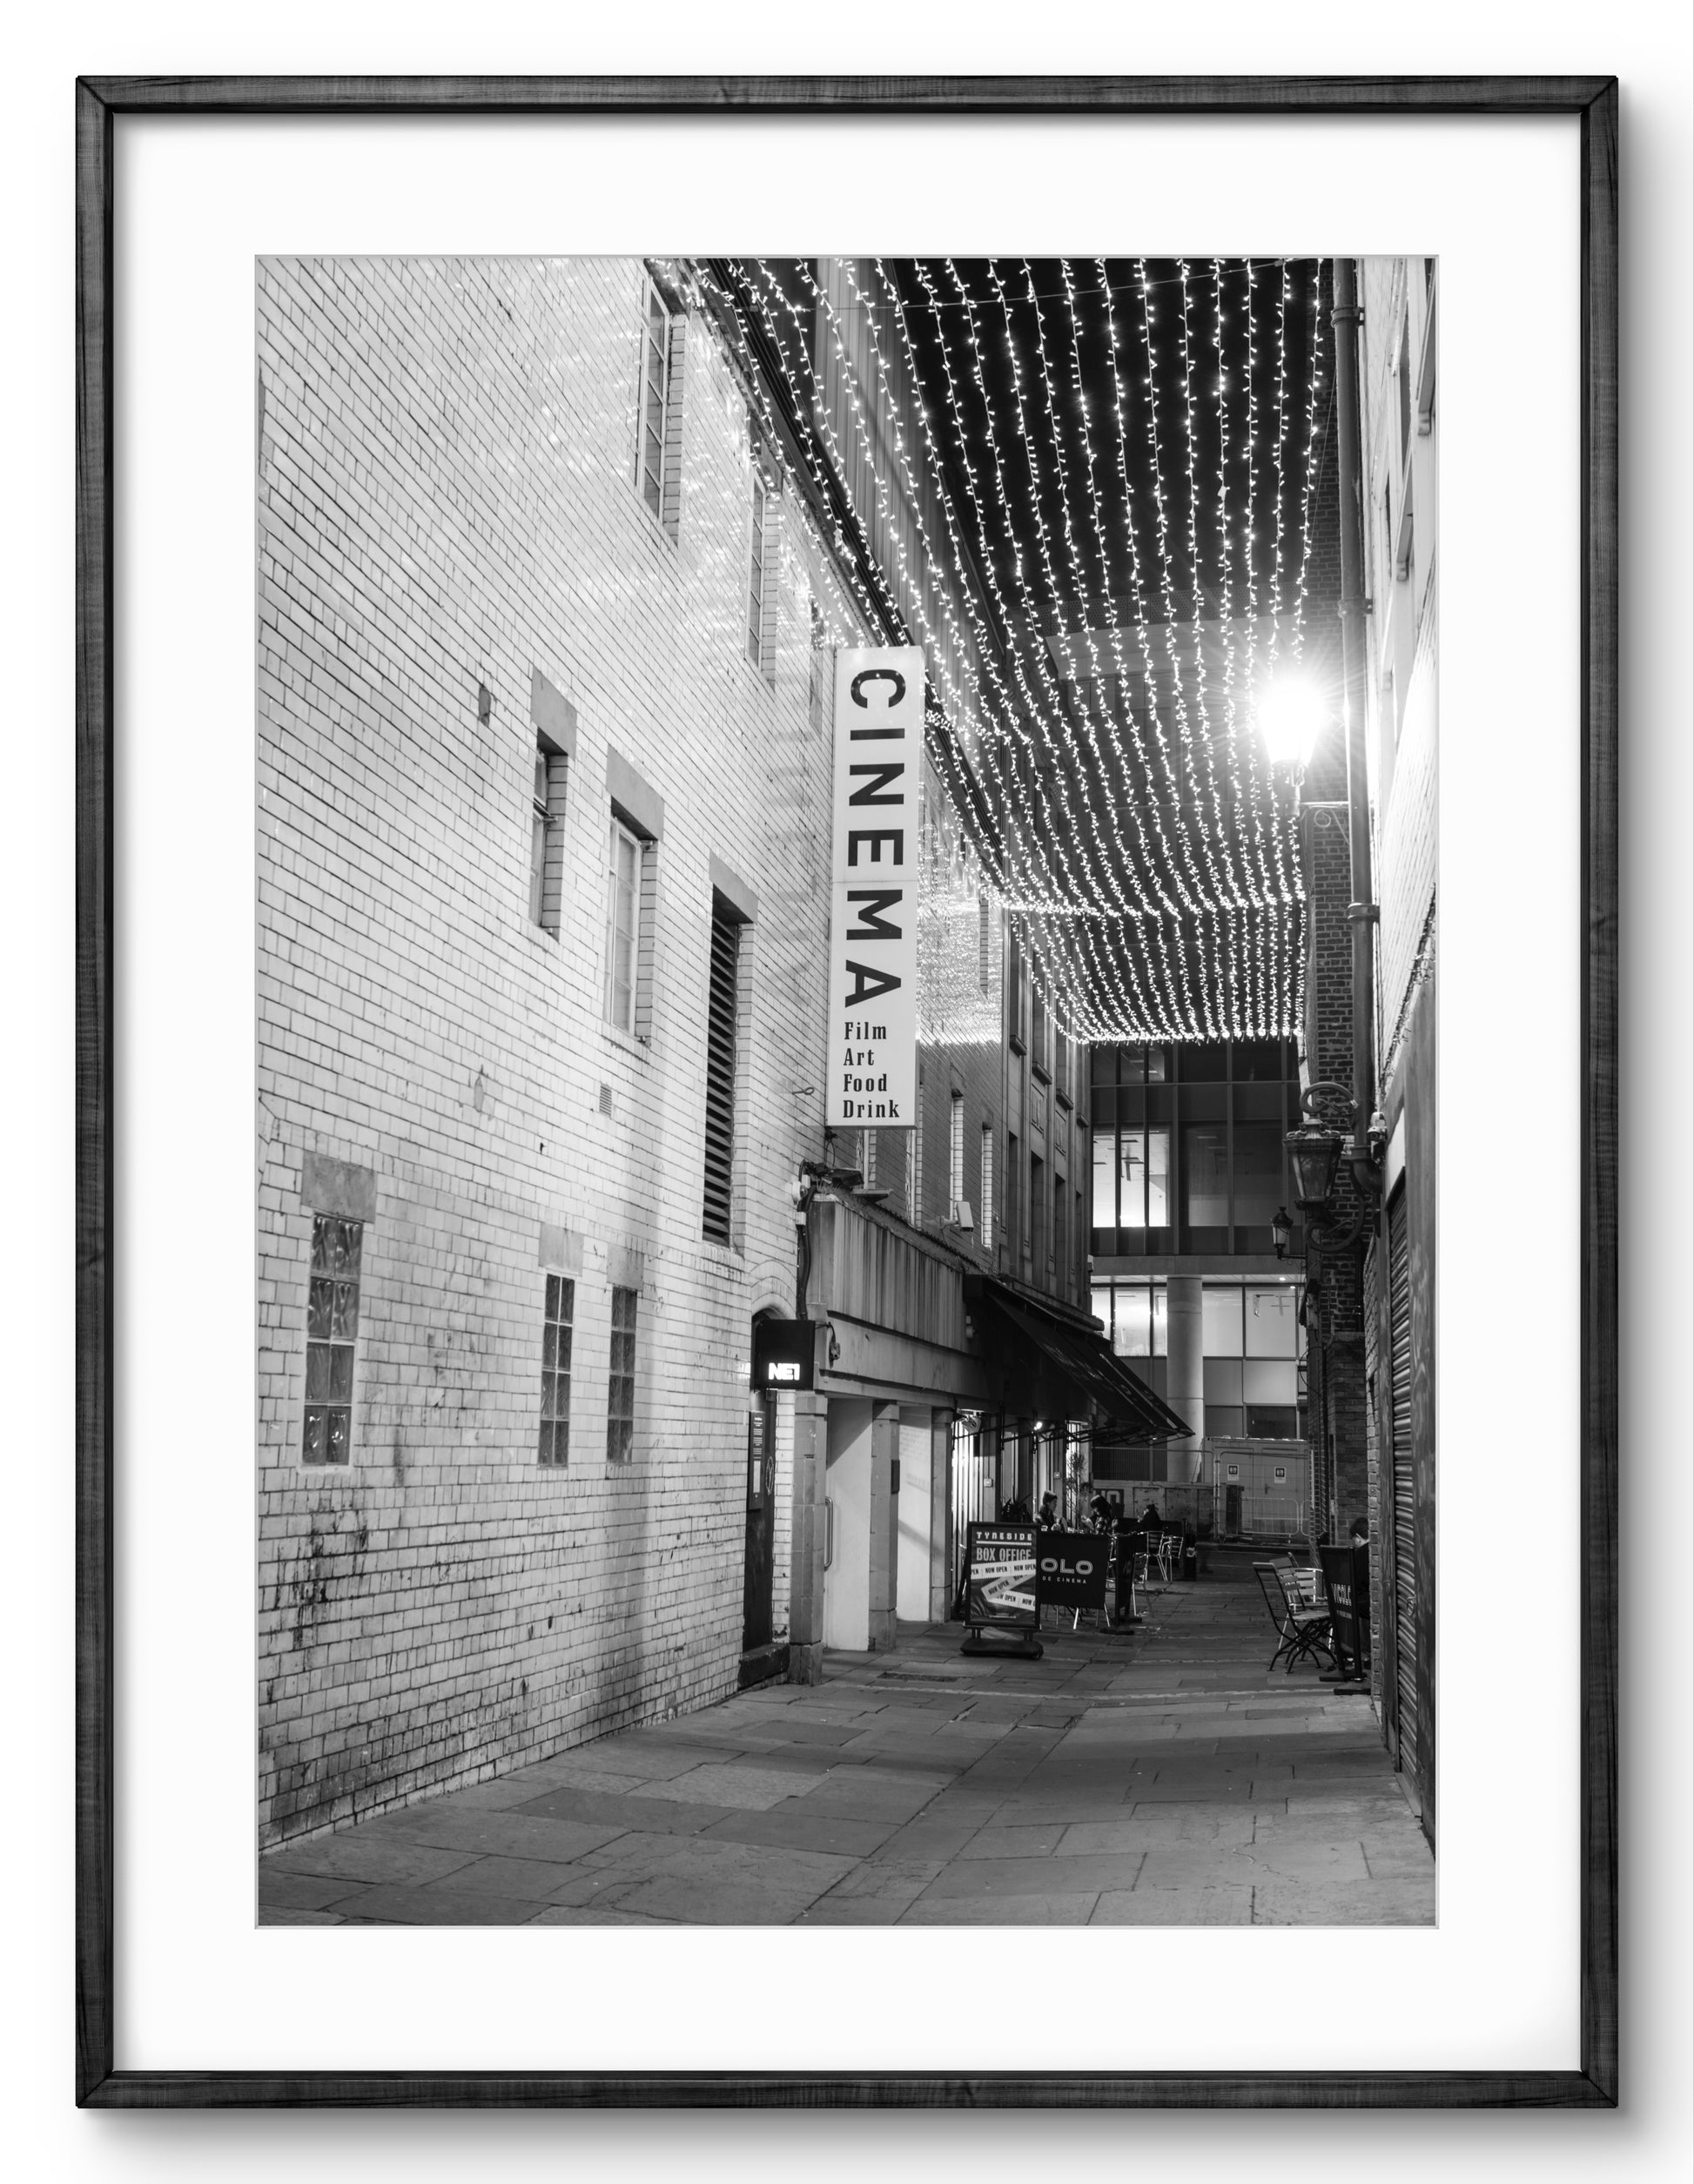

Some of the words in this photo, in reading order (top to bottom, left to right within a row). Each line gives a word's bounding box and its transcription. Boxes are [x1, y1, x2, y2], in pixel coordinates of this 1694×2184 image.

[844, 669, 906, 1008] CINEMA
[844, 1022, 886, 1039] Film
[844, 1048, 874, 1065] Art
[844, 1073, 887, 1092] Food
[843, 1099, 899, 1118] Drink
[976, 1532, 1032, 1541] TYNESIDE
[976, 1548, 996, 1561] BOX
[998, 1548, 1032, 1562] OFFICE
